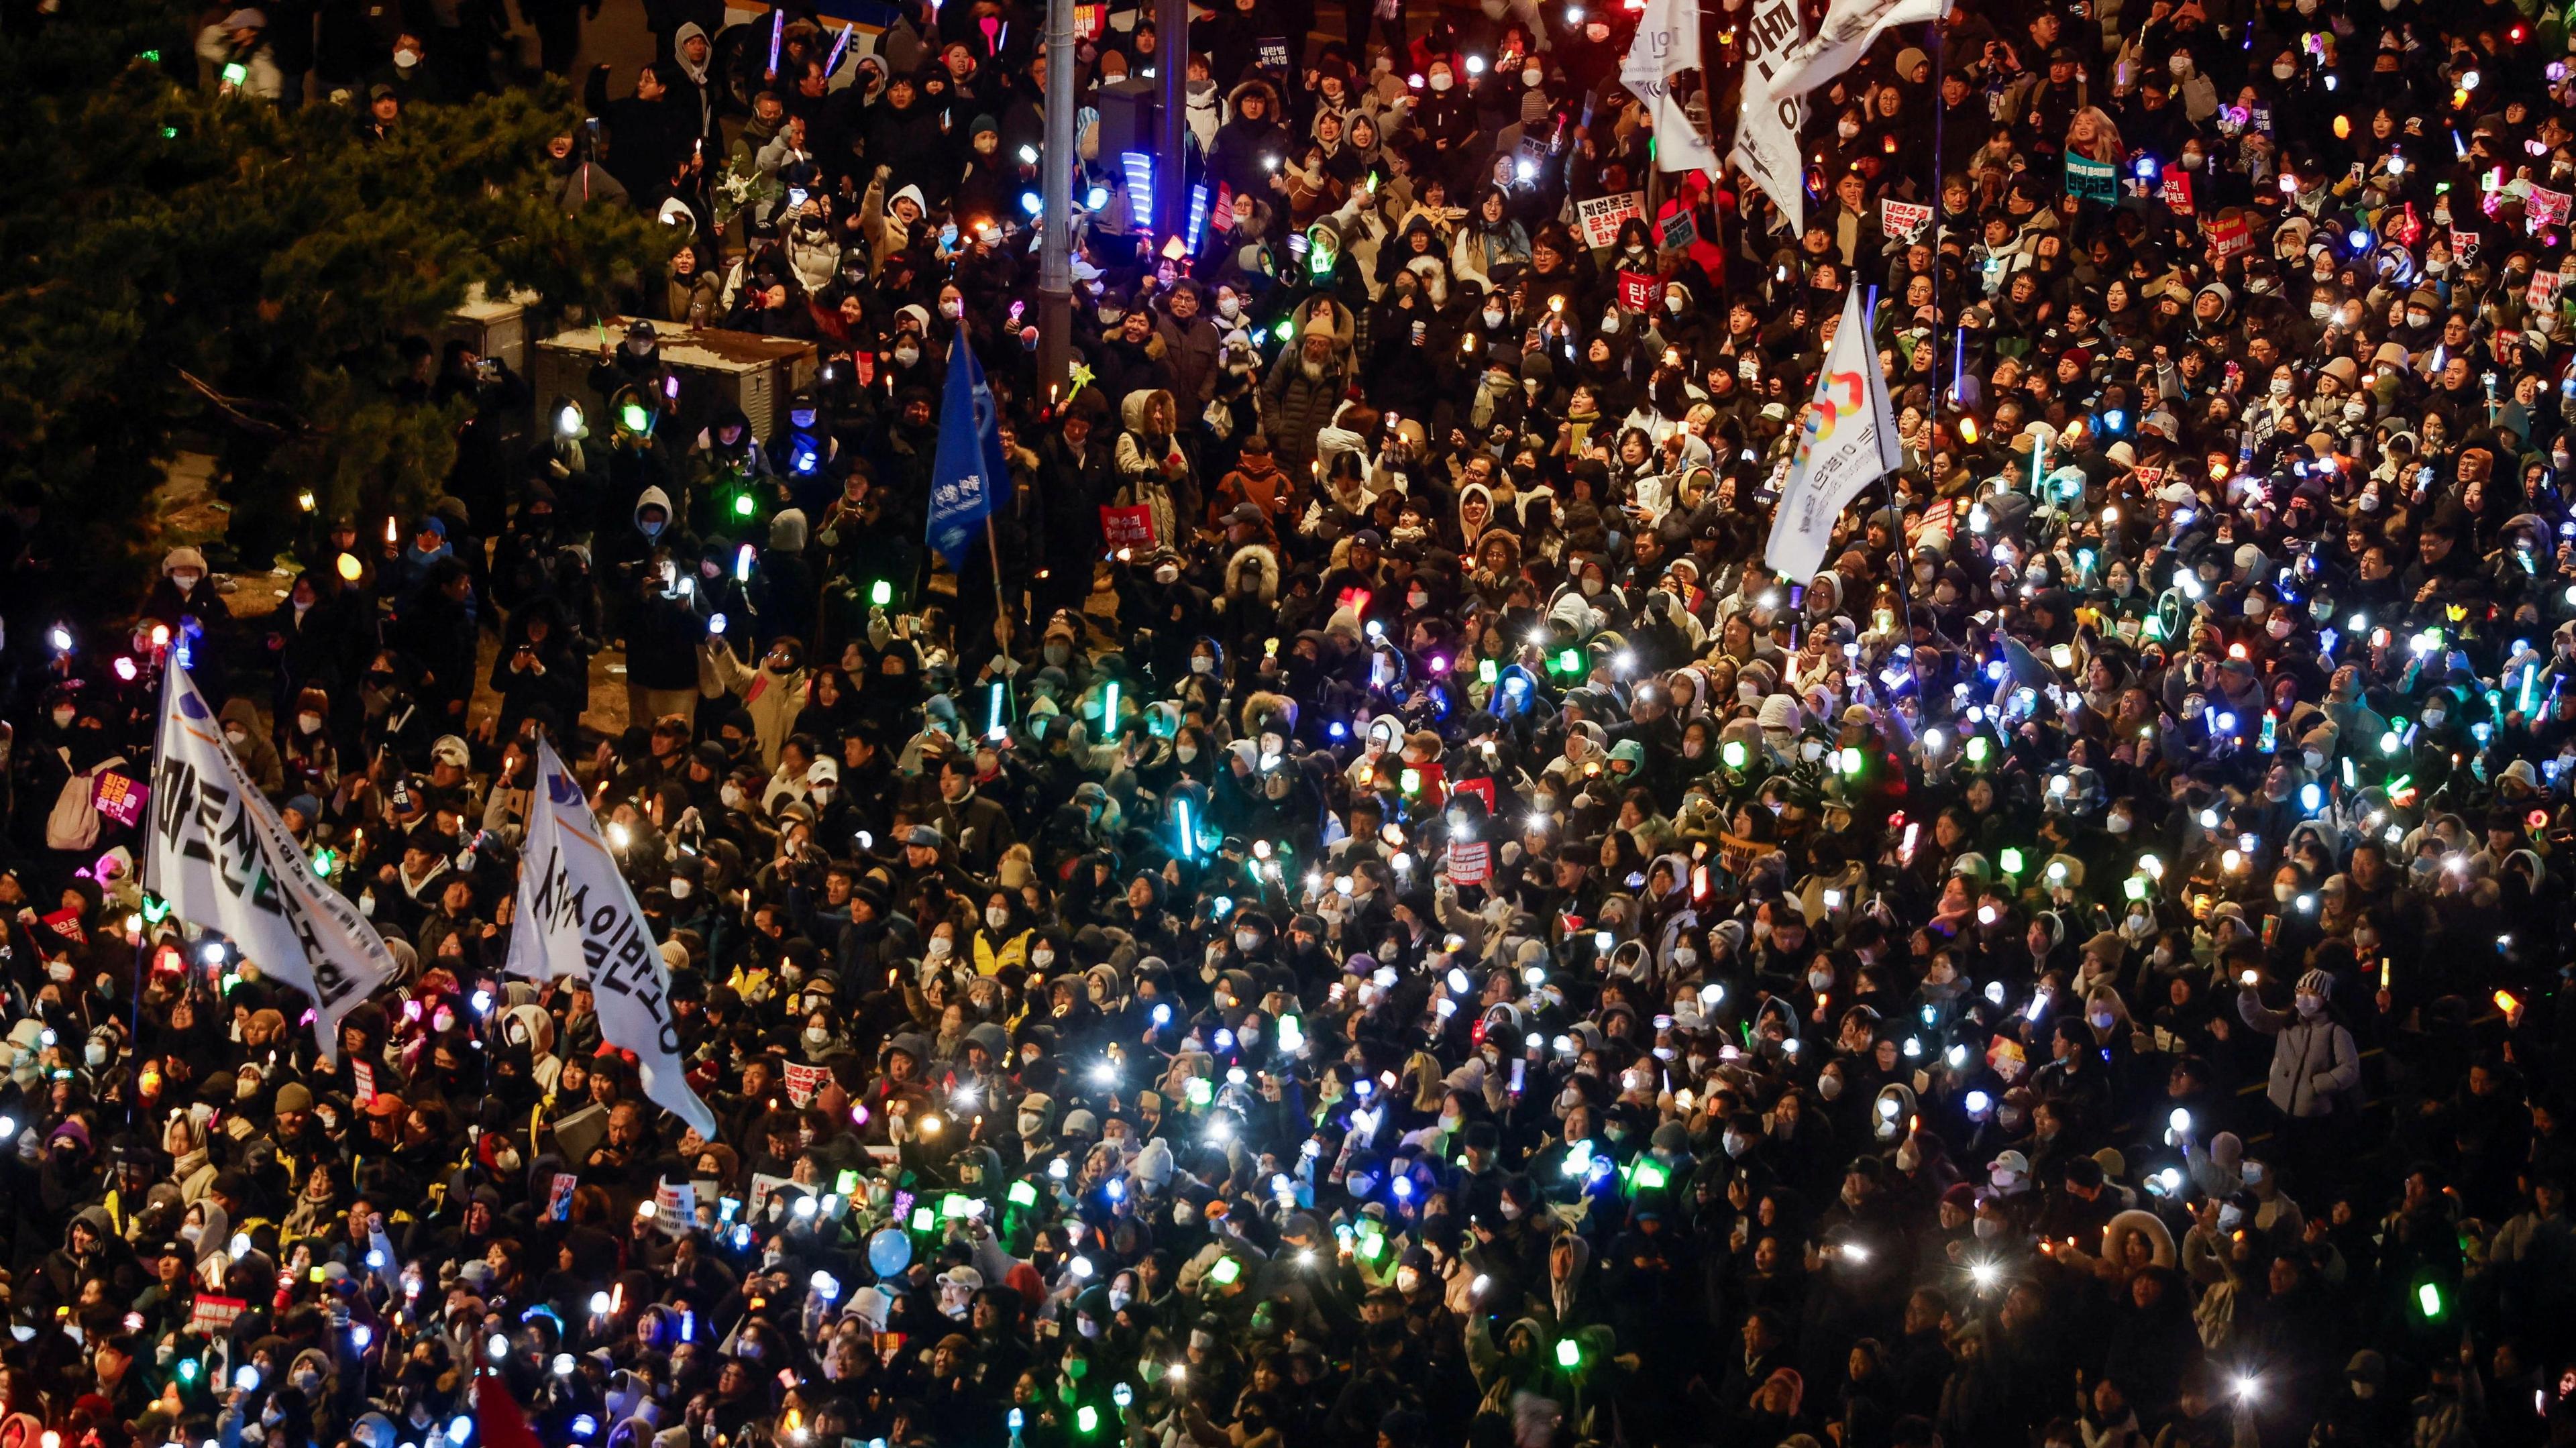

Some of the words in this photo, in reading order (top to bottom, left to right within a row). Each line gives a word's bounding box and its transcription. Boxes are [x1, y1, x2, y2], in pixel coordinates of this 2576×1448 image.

[1260, 46, 1285, 56] 내란범
[1262, 55, 1287, 65] 윤석열
[1582, 193, 1633, 217] 계엄폭군
[1886, 203, 1929, 220] 내란수괴
[1588, 207, 1641, 232] 윤석열을
[1885, 213, 1915, 227] 윤석열
[1629, 282, 1662, 306] 탄핵
[2255, 425, 2273, 445] 윤석열
